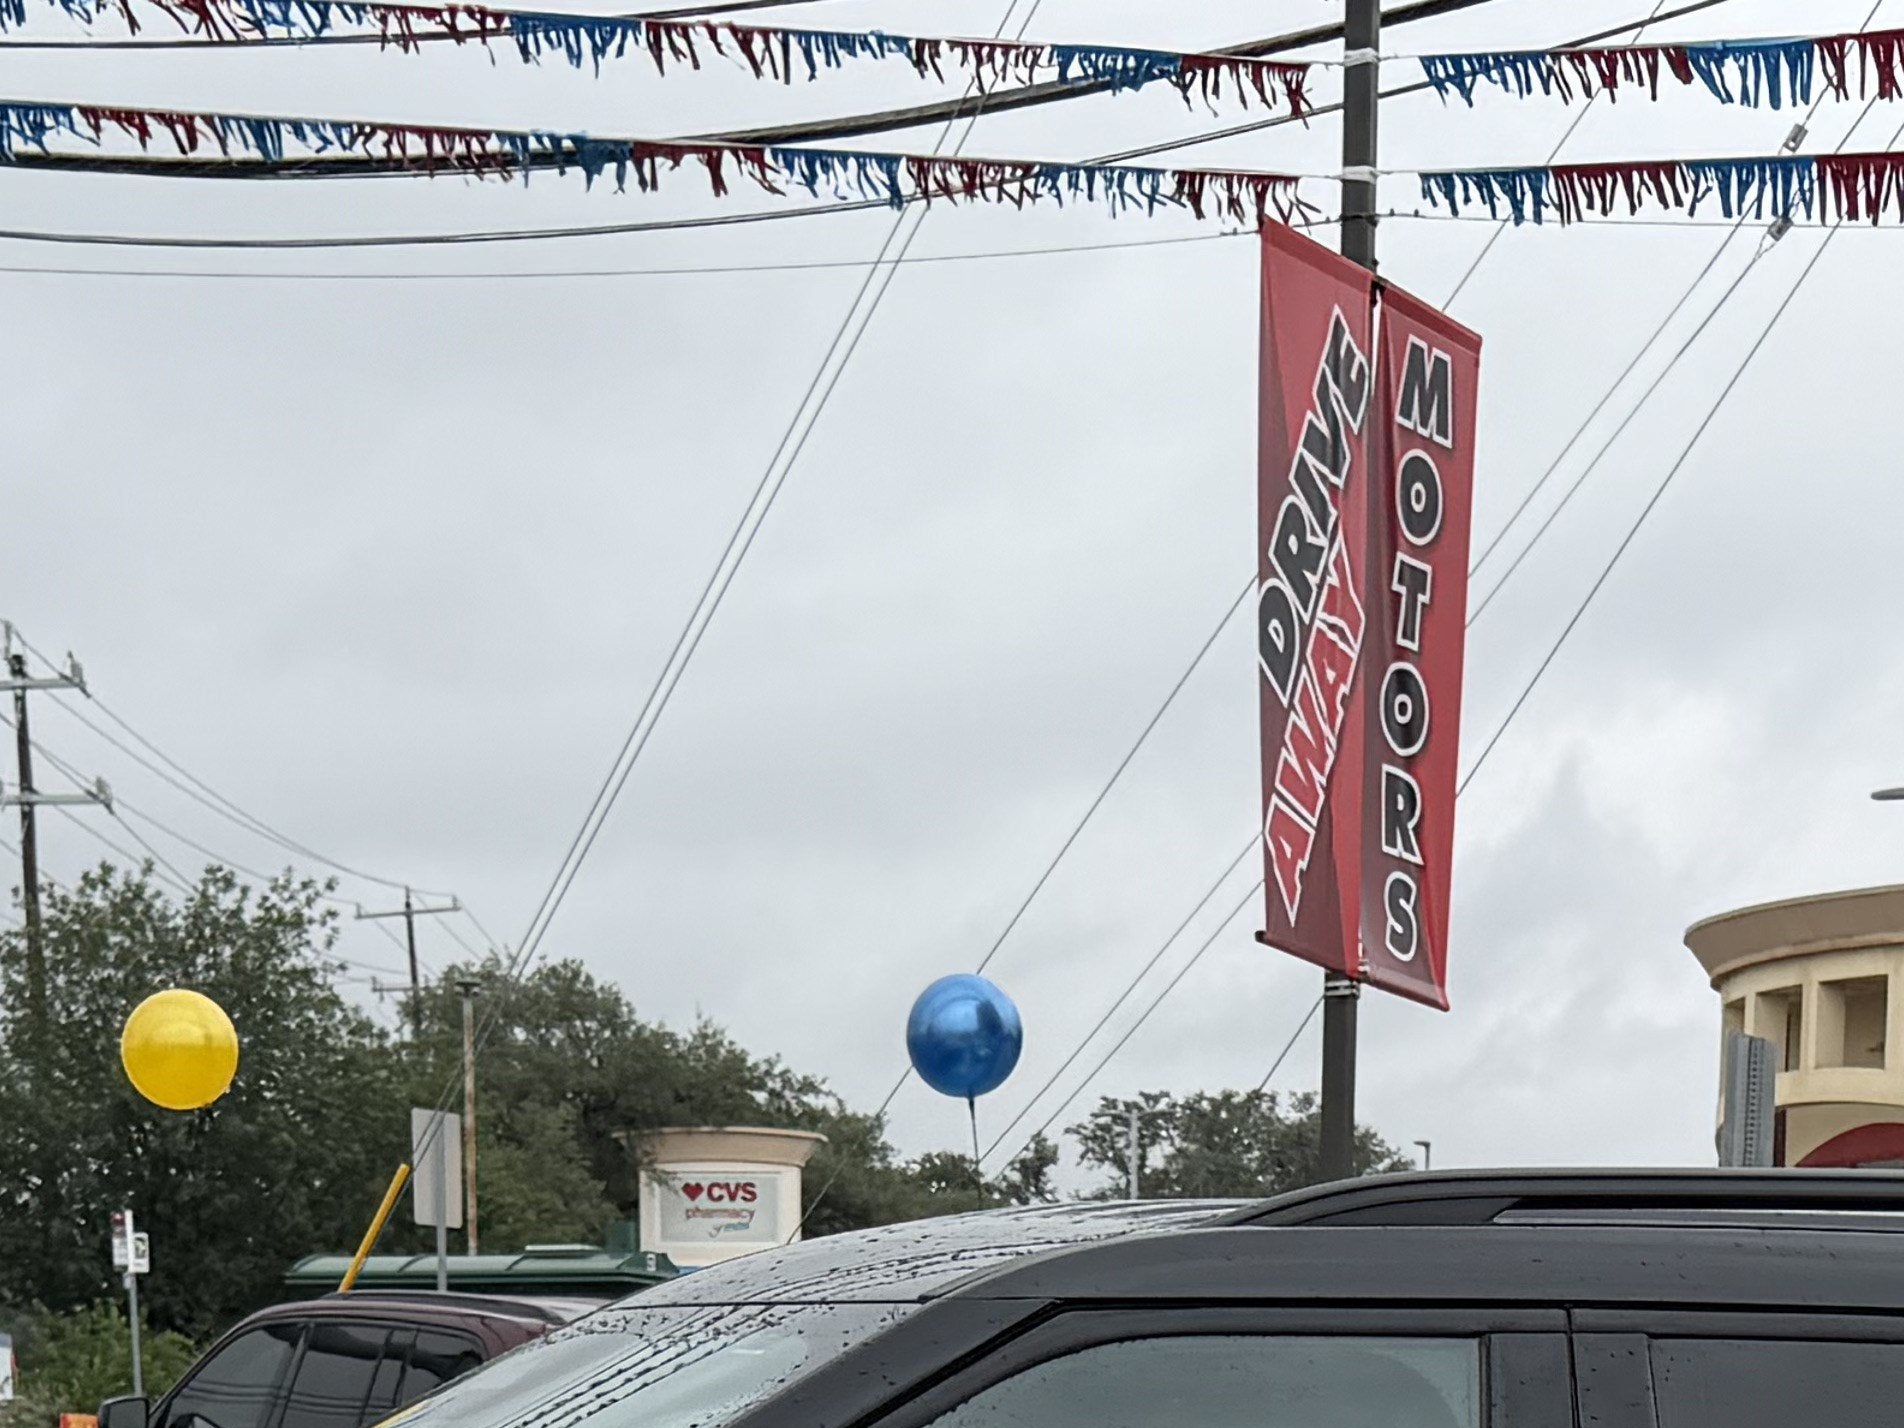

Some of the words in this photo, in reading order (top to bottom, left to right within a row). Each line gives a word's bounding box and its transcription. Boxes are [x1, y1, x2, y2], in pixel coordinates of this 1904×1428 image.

[1258, 304, 1371, 708] DRIVE
[1379, 334, 1454, 964] MOTORS
[1262, 529, 1366, 928] AWAY
[707, 1182, 758, 1202] CVS
